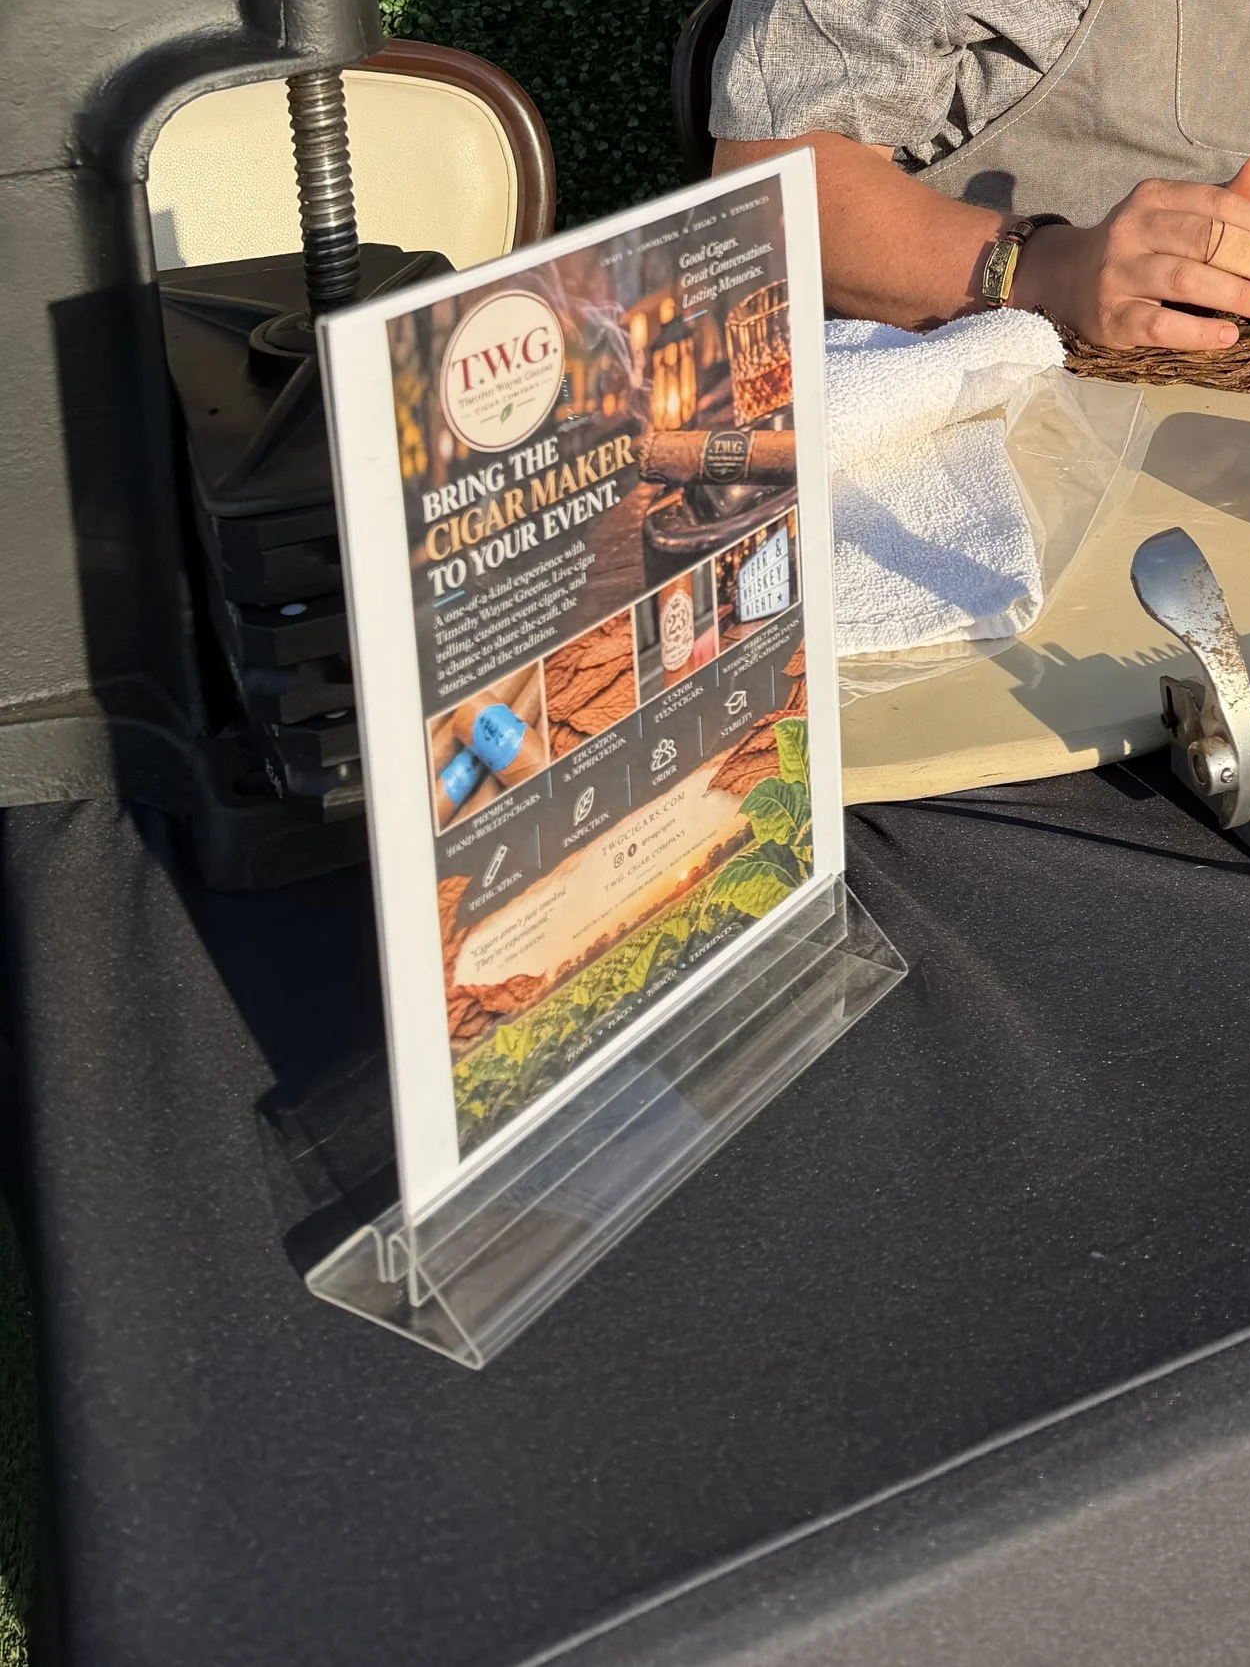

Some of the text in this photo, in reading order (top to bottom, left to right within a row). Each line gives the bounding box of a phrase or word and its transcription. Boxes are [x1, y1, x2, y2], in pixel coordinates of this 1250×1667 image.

[679, 238, 739, 268] Good Cigars.
[680, 242, 774, 288] Great Conversations.
[682, 266, 764, 309] Lasting Memories.
[452, 326, 558, 392] T.W.G.
[422, 436, 559, 522] BRING THE
[426, 488, 526, 560] CIGAR
[530, 435, 635, 512] MAKER
[428, 480, 620, 596] TO YOUR EVENT.
[742, 537, 783, 584] CIGAR &
[742, 564, 784, 600] WHISKEY
[434, 540, 585, 629] A one-of-a-kind experience with
[435, 553, 596, 645] Timothy Wayne Greene. Live cigar
[745, 593, 773, 617] NIGHT
[436, 572, 586, 664] rolling, custom event cigars, and
[438, 597, 577, 680] a chance to share the craft, the
[668, 609, 687, 632] 23
[438, 626, 558, 696] stories, and the tradition.
[655, 686, 704, 723] EVENT CIGARS
[663, 681, 692, 705] CUSTOM
[720, 712, 752, 736] STABILITY
[573, 738, 626, 775] APPRECIATION
[574, 732, 617, 764] EDUCATION
[652, 765, 677, 785] ORDER
[472, 797, 514, 828] PREMIUM
[510, 793, 540, 817] CIGARS
[601, 792, 684, 856] TWGCIGARS.COM
[627, 855, 650, 875] CIGAR
[652, 830, 685, 858] COMPANY
[690, 926, 732, 962] EXPERIENCES
